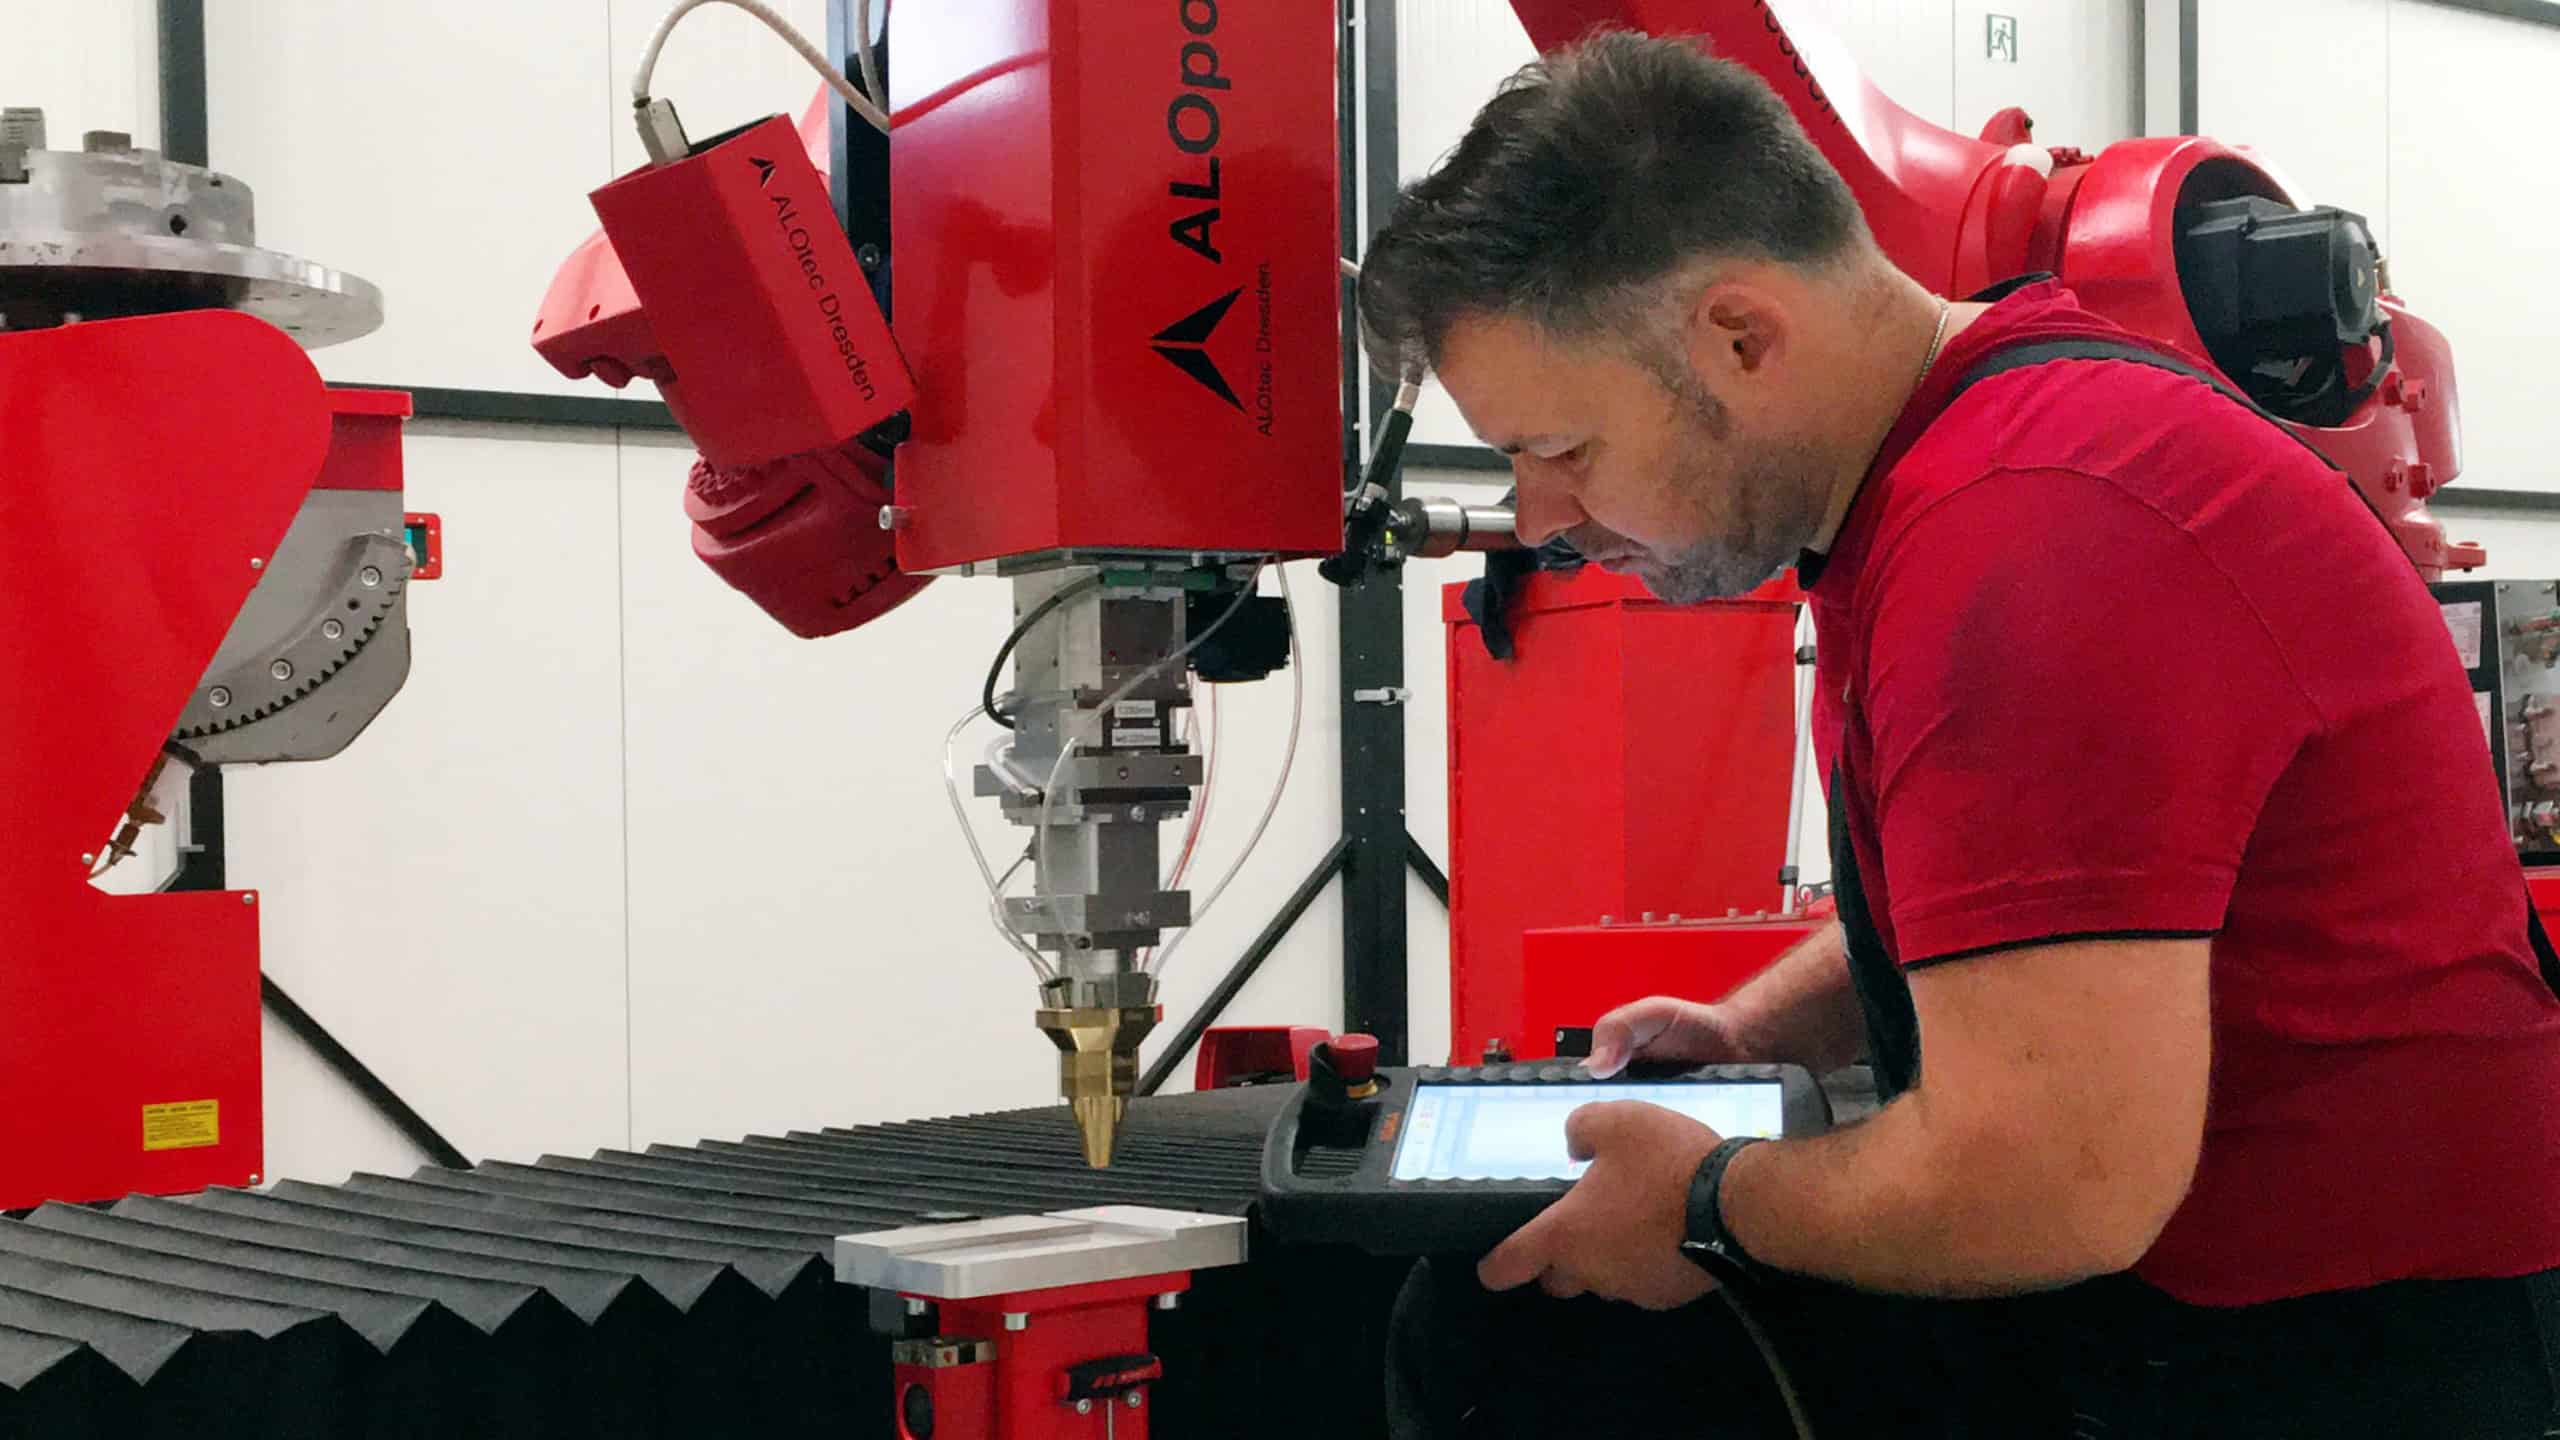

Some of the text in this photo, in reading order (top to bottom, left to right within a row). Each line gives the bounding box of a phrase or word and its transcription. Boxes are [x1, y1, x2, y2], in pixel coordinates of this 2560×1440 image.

[770, 195, 876, 402] ALOtec Dresden
[1256, 260, 1273, 437] ALOtec Dresden
